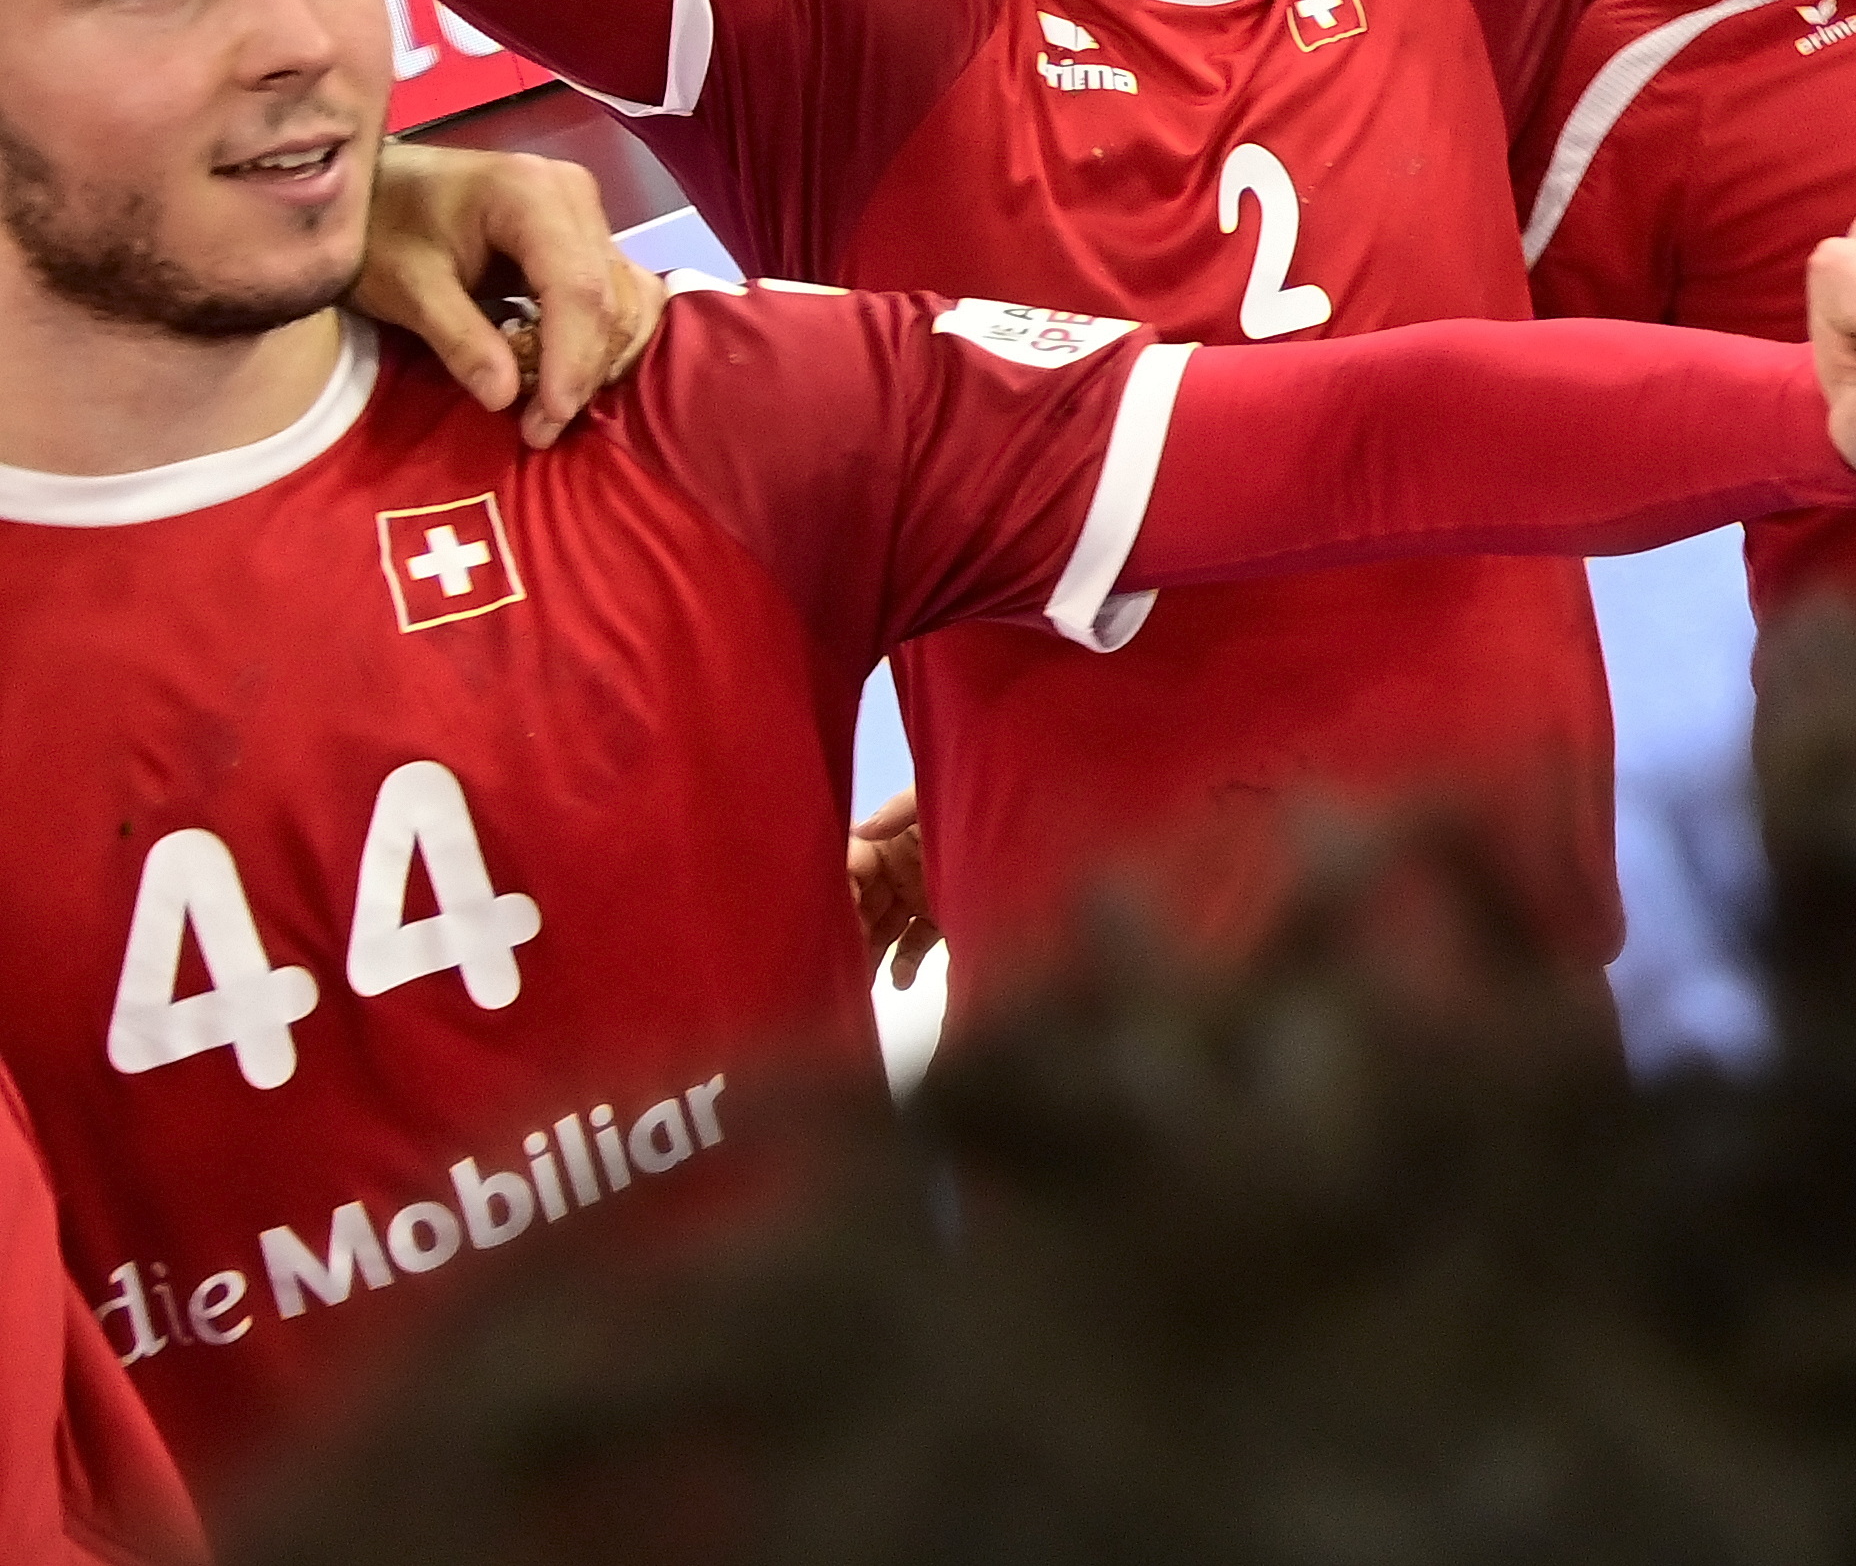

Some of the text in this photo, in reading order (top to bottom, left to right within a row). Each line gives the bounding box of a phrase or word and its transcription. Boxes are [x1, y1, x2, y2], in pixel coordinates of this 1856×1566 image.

[1217, 143, 1332, 340] 2
[107, 760, 542, 1089] 44
[92, 1073, 726, 1368] die Mobiliar
